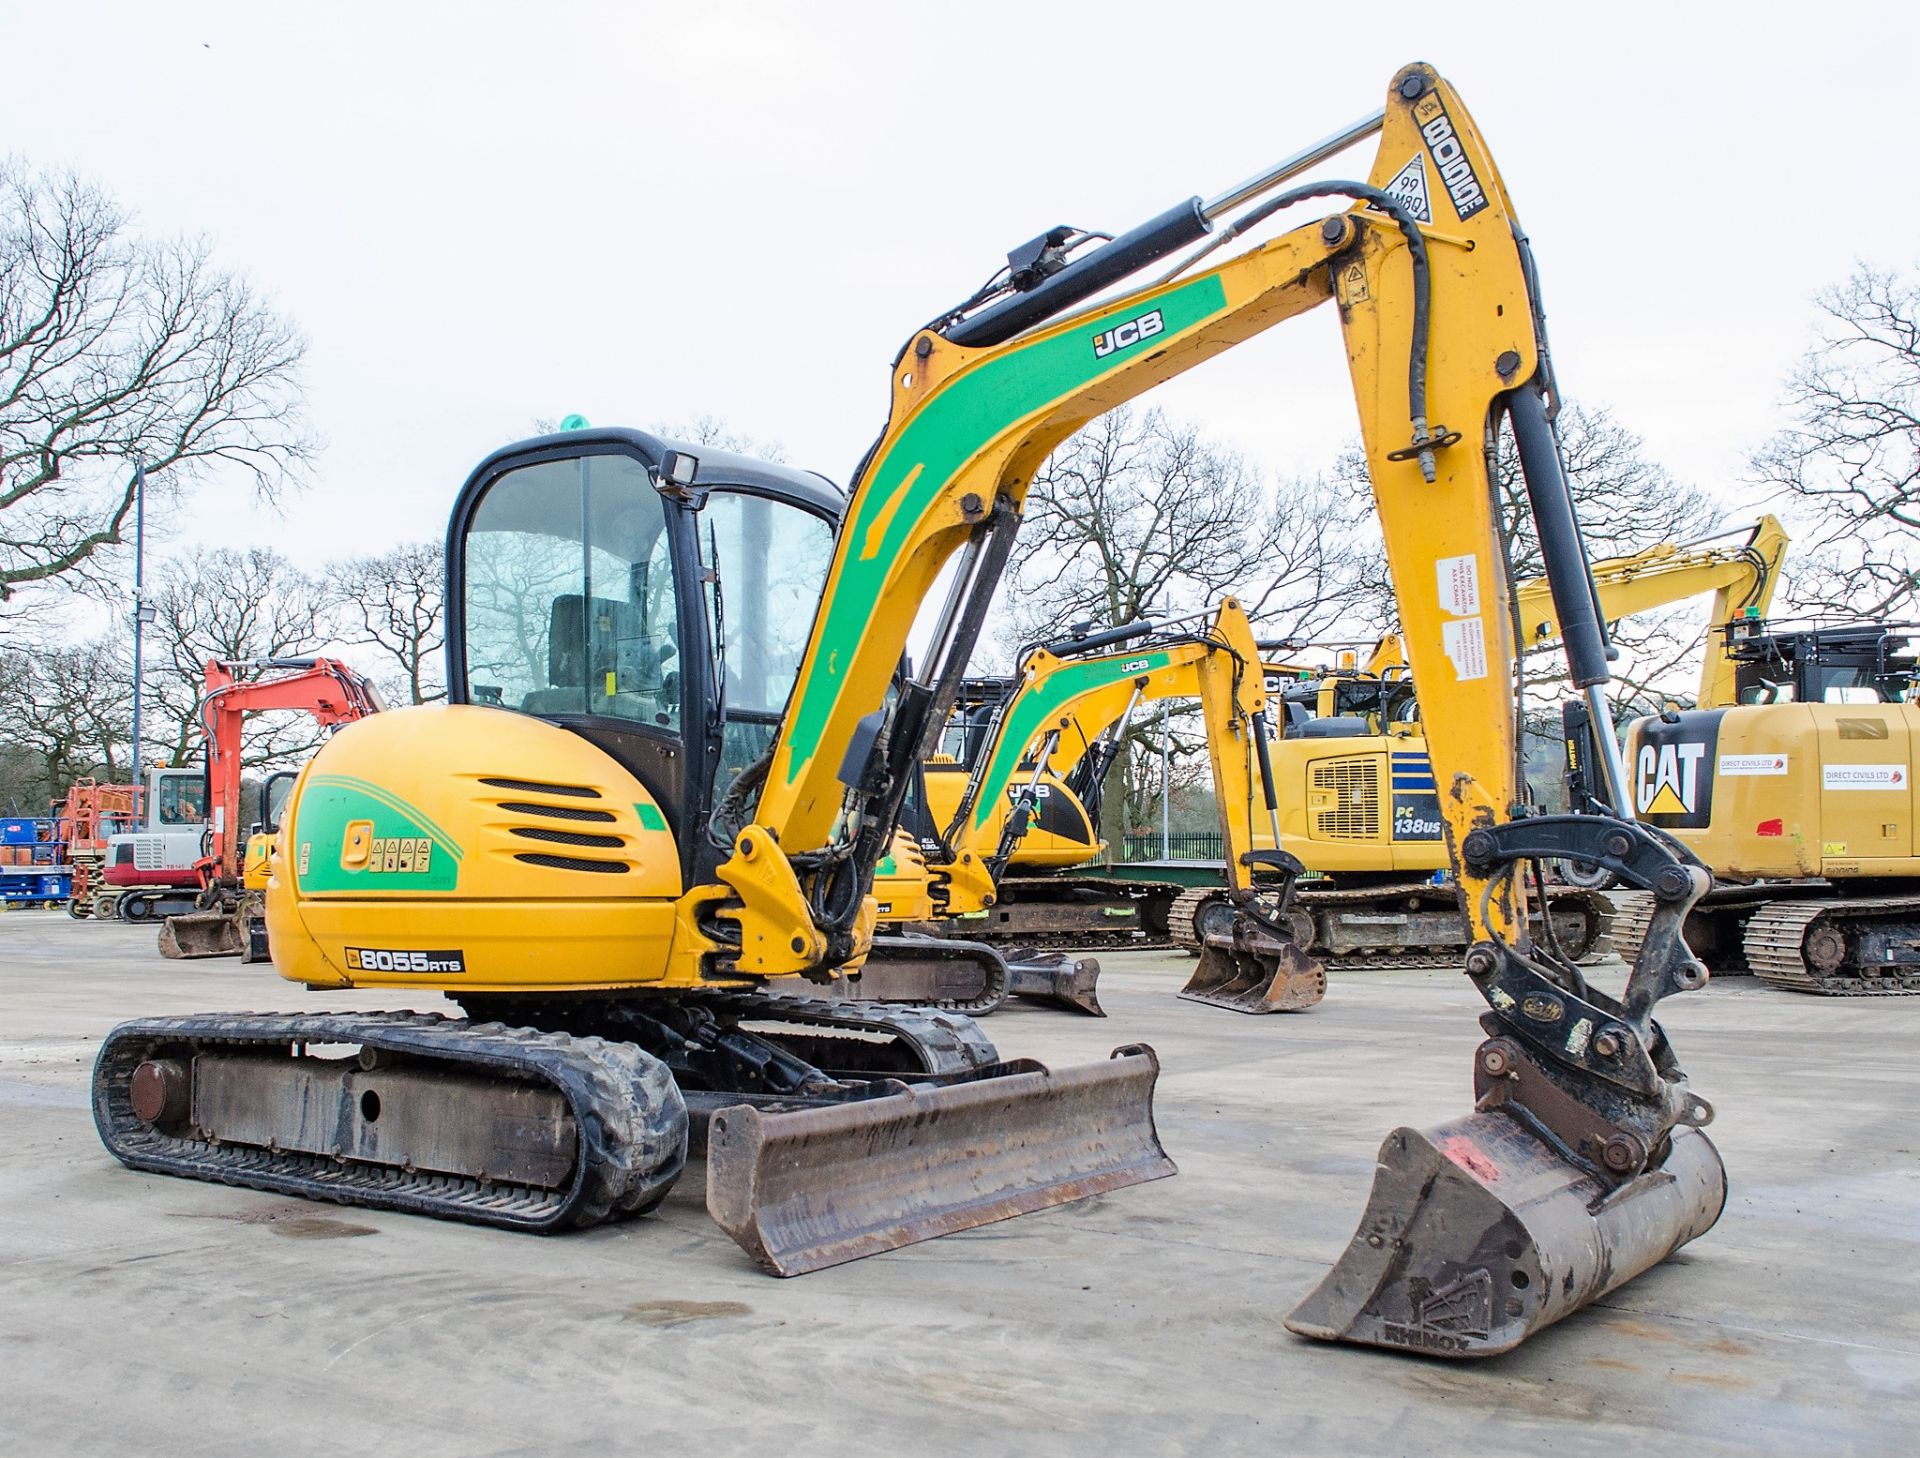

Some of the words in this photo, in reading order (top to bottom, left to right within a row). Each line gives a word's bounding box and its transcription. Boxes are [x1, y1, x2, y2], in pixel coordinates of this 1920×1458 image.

[1401, 176, 1419, 193] 99
[1093, 311, 1164, 357] JCB
[1121, 659, 1149, 672] JCB
[1637, 743, 1705, 814] CAT
[1825, 771, 1851, 779] DIRECT
[1852, 771, 1875, 779] CIVILS
[1876, 771, 1889, 779] LTD
[1395, 806, 1414, 818] PC
[1384, 1323, 1471, 1351] RHINOX
